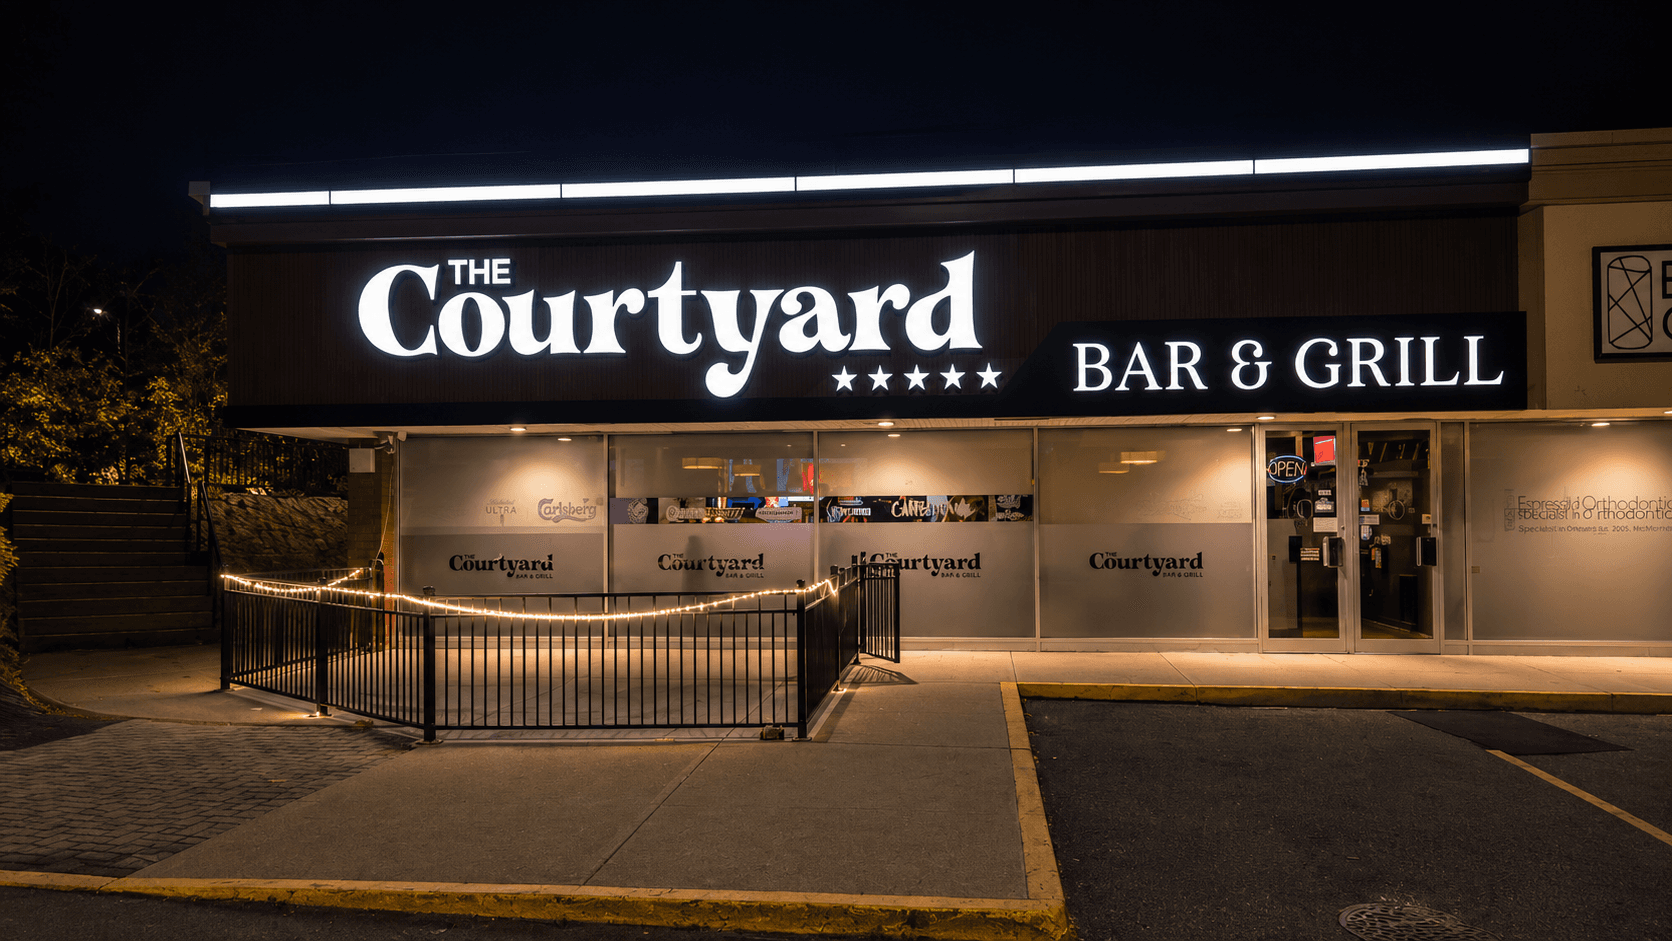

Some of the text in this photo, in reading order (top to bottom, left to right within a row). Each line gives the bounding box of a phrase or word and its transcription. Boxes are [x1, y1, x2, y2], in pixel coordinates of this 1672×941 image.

[448, 258, 511, 285] THE
[358, 250, 983, 398] Courtyard
[1072, 336, 1504, 392] BAR & GRILL
[1270, 461, 1305, 477] OPEN
[486, 506, 517, 515] ULTRA
[537, 498, 597, 523] Carlsberg
[449, 554, 554, 578] Courtyard
[657, 553, 764, 577] Courtyard
[1089, 552, 1204, 577] Courtyard
